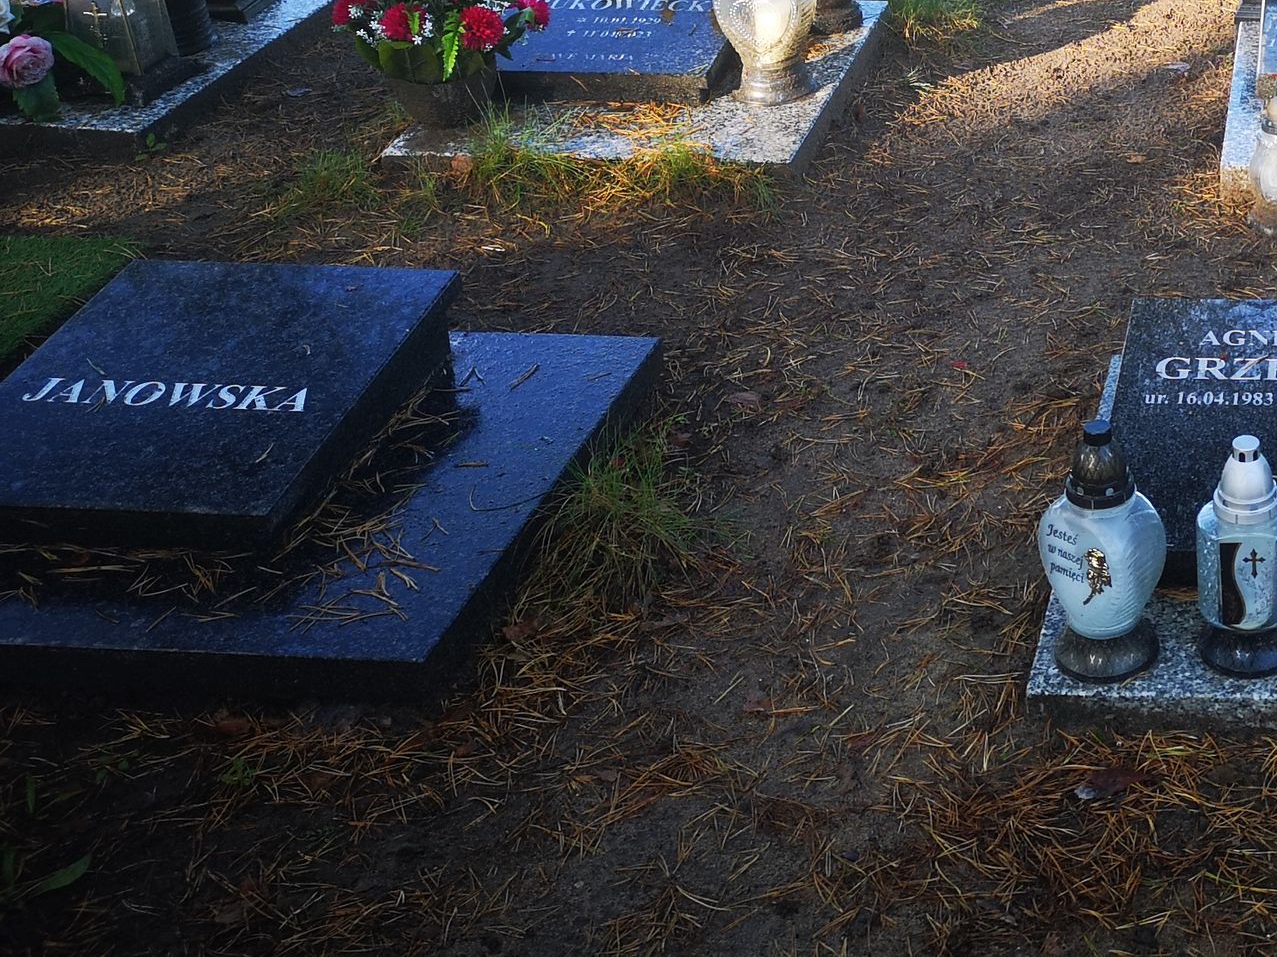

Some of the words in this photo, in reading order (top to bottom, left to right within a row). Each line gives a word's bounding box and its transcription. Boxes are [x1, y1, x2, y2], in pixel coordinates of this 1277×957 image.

[22, 377, 309, 412] JANOWSKA
[1144, 393, 1169, 406] ur.
[1176, 392, 1274, 407] 16.04.1983
[1046, 524, 1079, 545] Jesteś
[1047, 544, 1057, 554] w
[1058, 548, 1084, 570] naszej
[1050, 562, 1085, 583] pamięci
